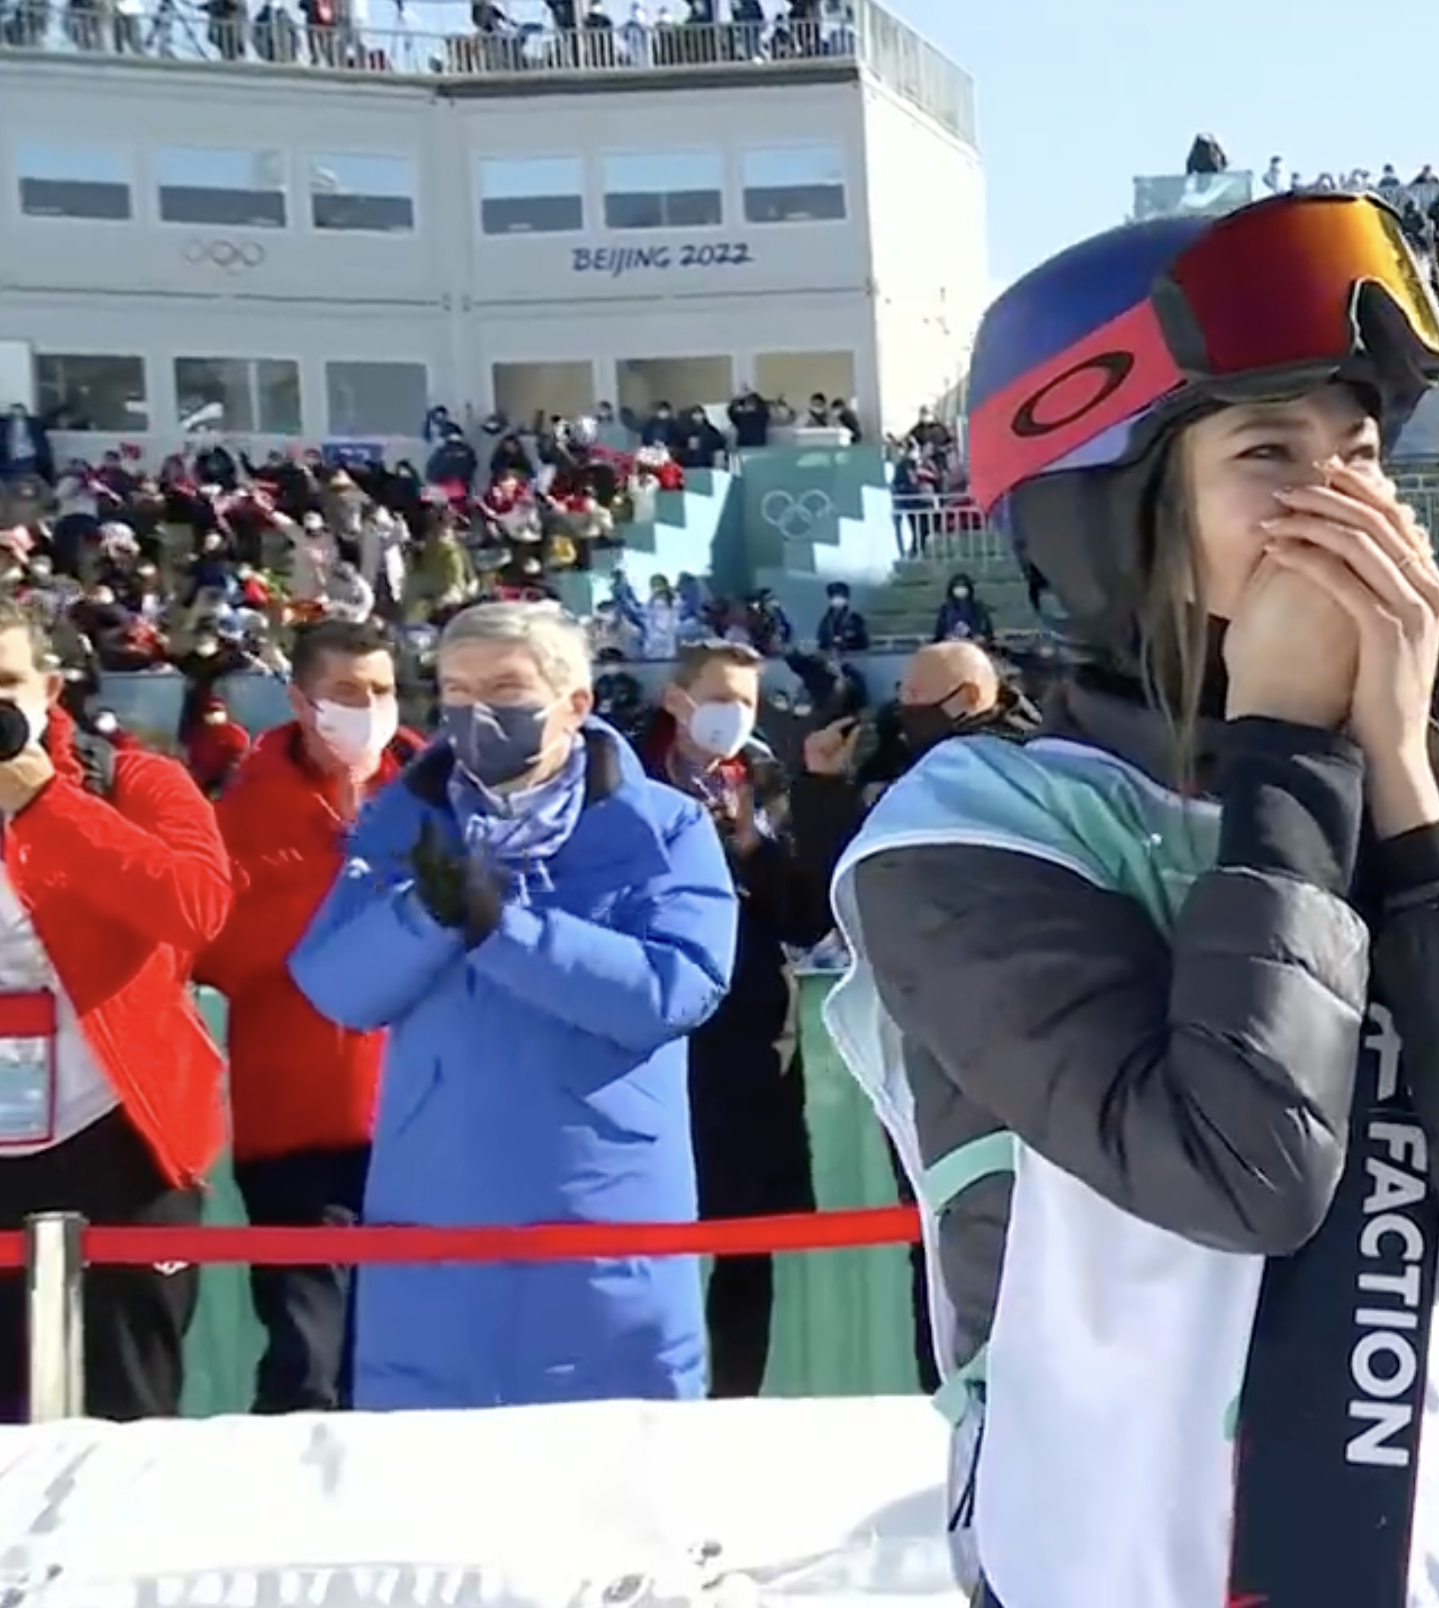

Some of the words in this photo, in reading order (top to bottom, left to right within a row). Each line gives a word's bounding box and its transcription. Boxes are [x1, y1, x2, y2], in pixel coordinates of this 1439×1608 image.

[572, 246, 671, 278] BEIJING
[679, 242, 755, 267] 2022
[1345, 1122, 1428, 1466] FACTION
